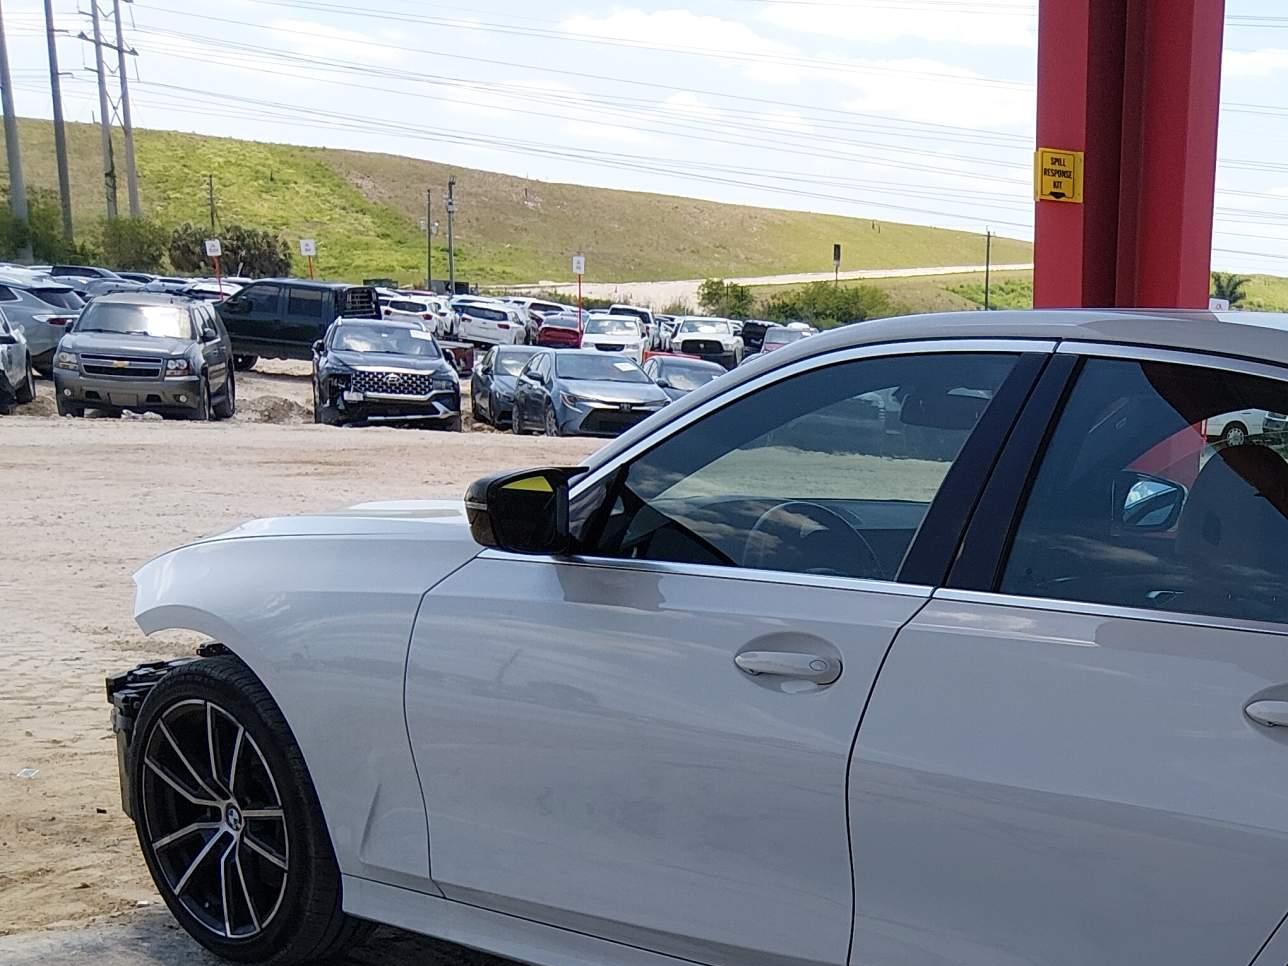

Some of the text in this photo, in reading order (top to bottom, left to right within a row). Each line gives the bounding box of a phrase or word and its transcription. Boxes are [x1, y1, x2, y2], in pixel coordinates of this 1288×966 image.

[1051, 157, 1065, 167] SPILL
[1044, 168, 1072, 179] RESPONSE
[1053, 181, 1062, 189] KIT
